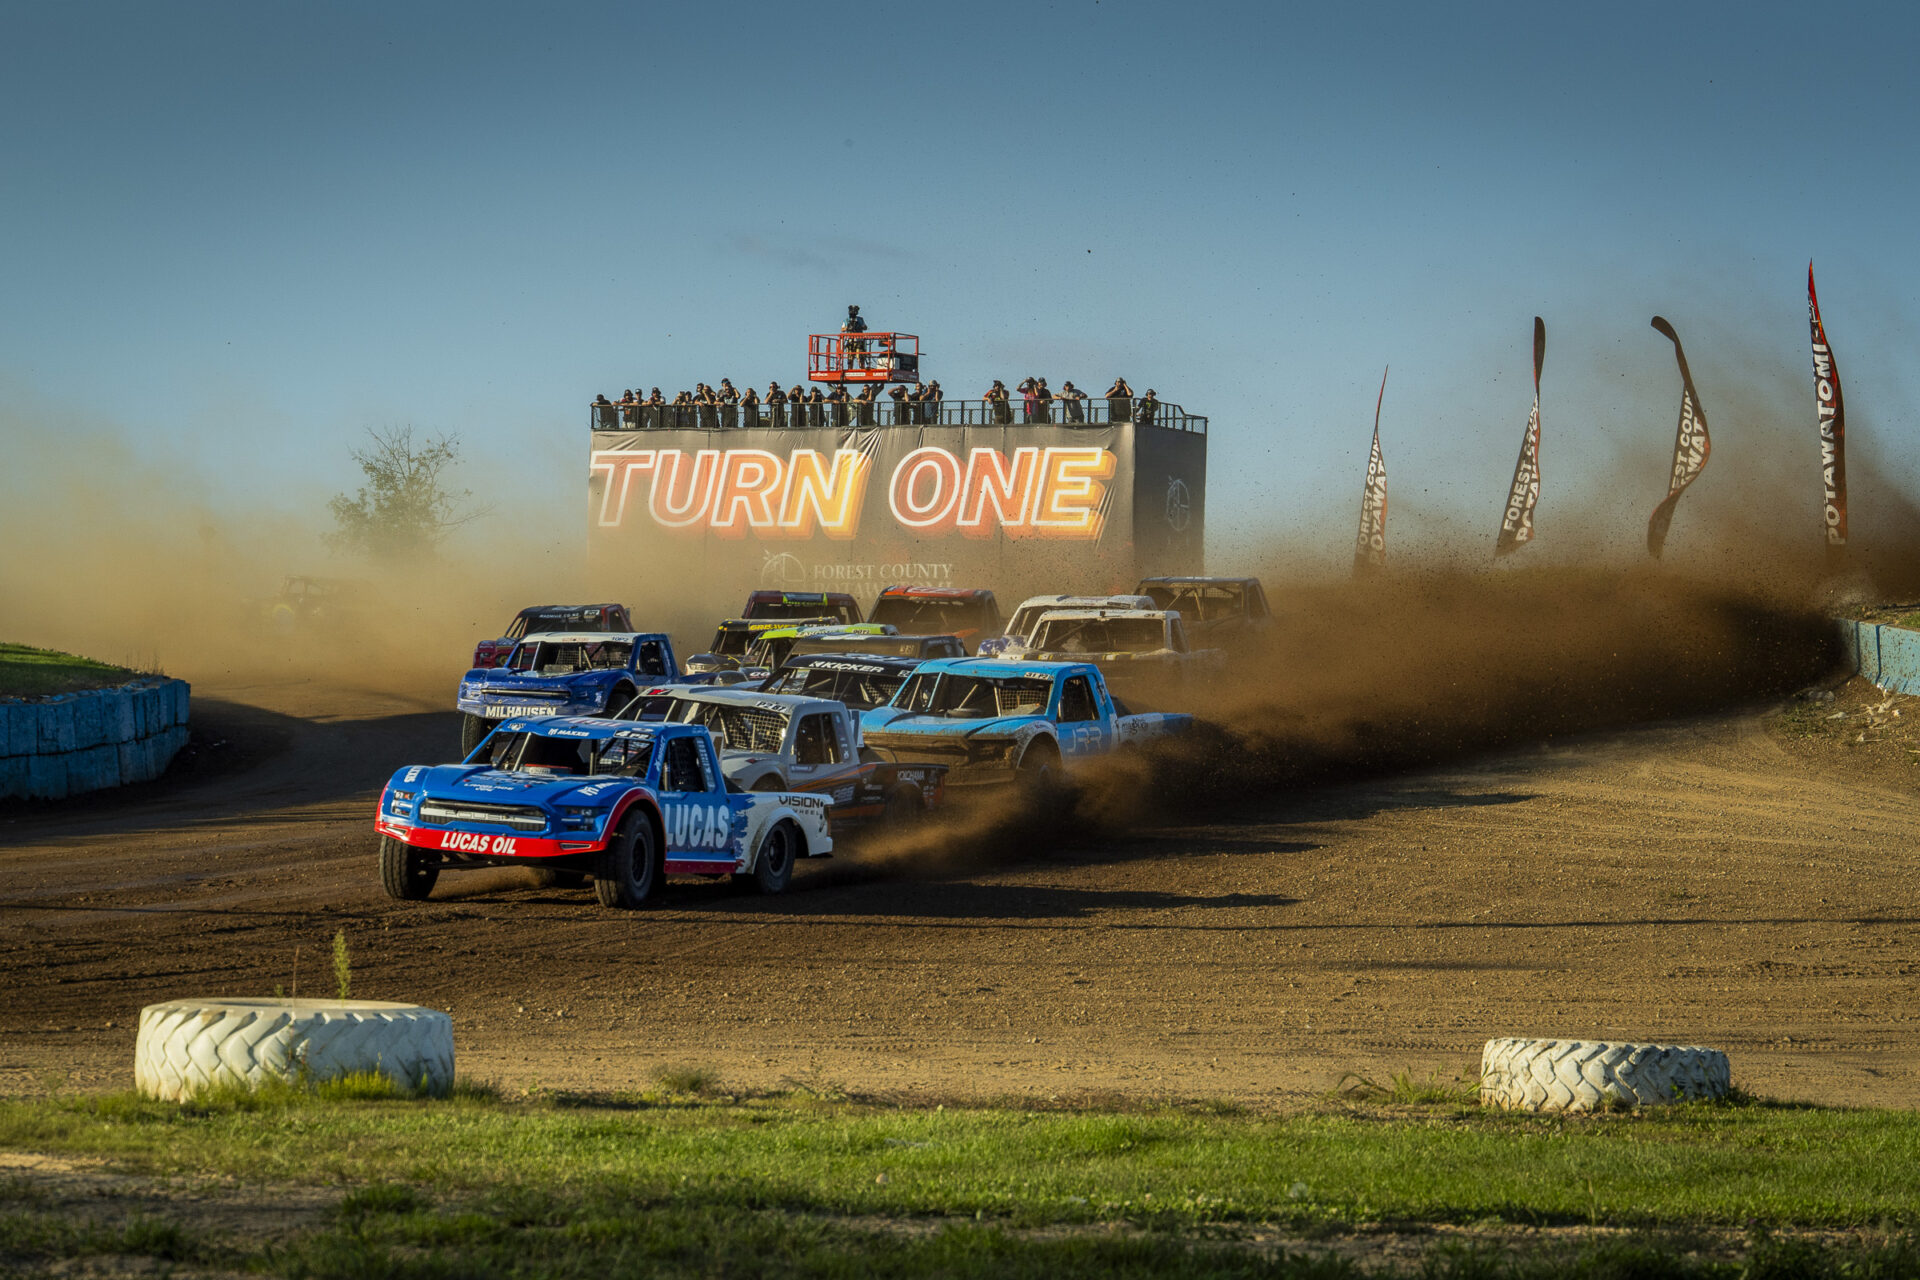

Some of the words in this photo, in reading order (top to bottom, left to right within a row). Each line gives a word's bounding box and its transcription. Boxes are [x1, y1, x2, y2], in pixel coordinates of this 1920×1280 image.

[1812, 343, 1846, 546] POTAWATOMI
[1671, 451, 1688, 492] EST
[589, 449, 867, 533] TURN
[888, 447, 1113, 536] ONE
[1503, 461, 1532, 532] FOREST
[813, 564, 875, 580] FOREST
[878, 563, 953, 579] COUNTY
[820, 661, 885, 673] KICKER
[485, 706, 556, 717] MILHAUSEN
[557, 729, 590, 737] MAXXIS
[778, 795, 821, 808] VISION
[664, 803, 730, 849] LUCAS
[440, 831, 489, 852] LUCAS
[492, 837, 517, 855] OIL
